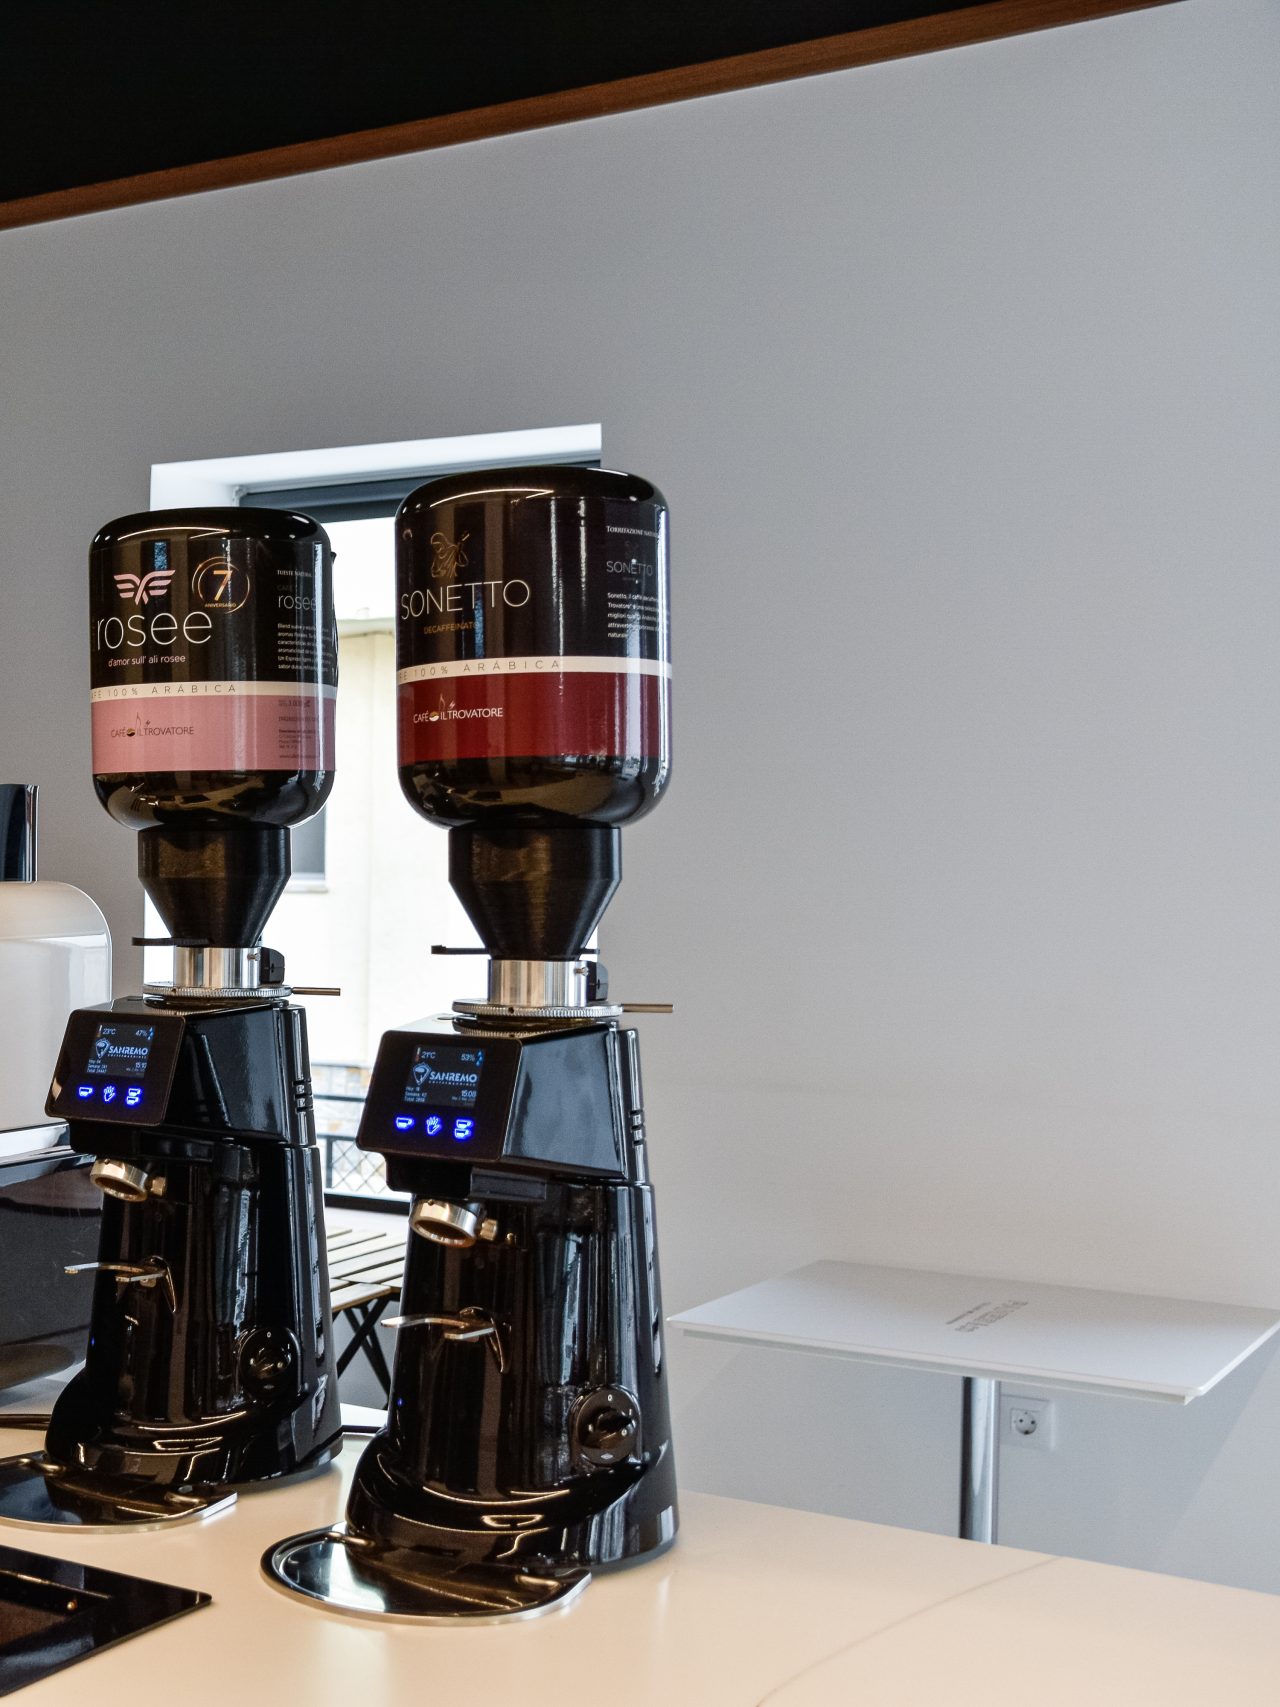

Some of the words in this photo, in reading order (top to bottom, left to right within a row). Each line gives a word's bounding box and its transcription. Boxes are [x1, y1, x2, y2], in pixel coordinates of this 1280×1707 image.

[606, 561, 653, 577] SONETTO
[213, 570, 232, 601] 7
[401, 580, 530, 620] SONETTO
[97, 611, 212, 650] rosee
[424, 621, 479, 634] DECAFFEINATO
[108, 658, 129, 667] d'amor
[131, 656, 146, 665] sull'
[149, 655, 158, 663] ali
[160, 655, 186, 663] rosee
[414, 666, 448, 677] 100%
[413, 709, 429, 723] CAFÉ
[447, 707, 503, 720] TROVATORE
[111, 726, 126, 737] CAFÉ
[143, 726, 195, 737] TROVATORE
[108, 1046, 148, 1055] SANREMO
[429, 1071, 478, 1083] SANREMO
